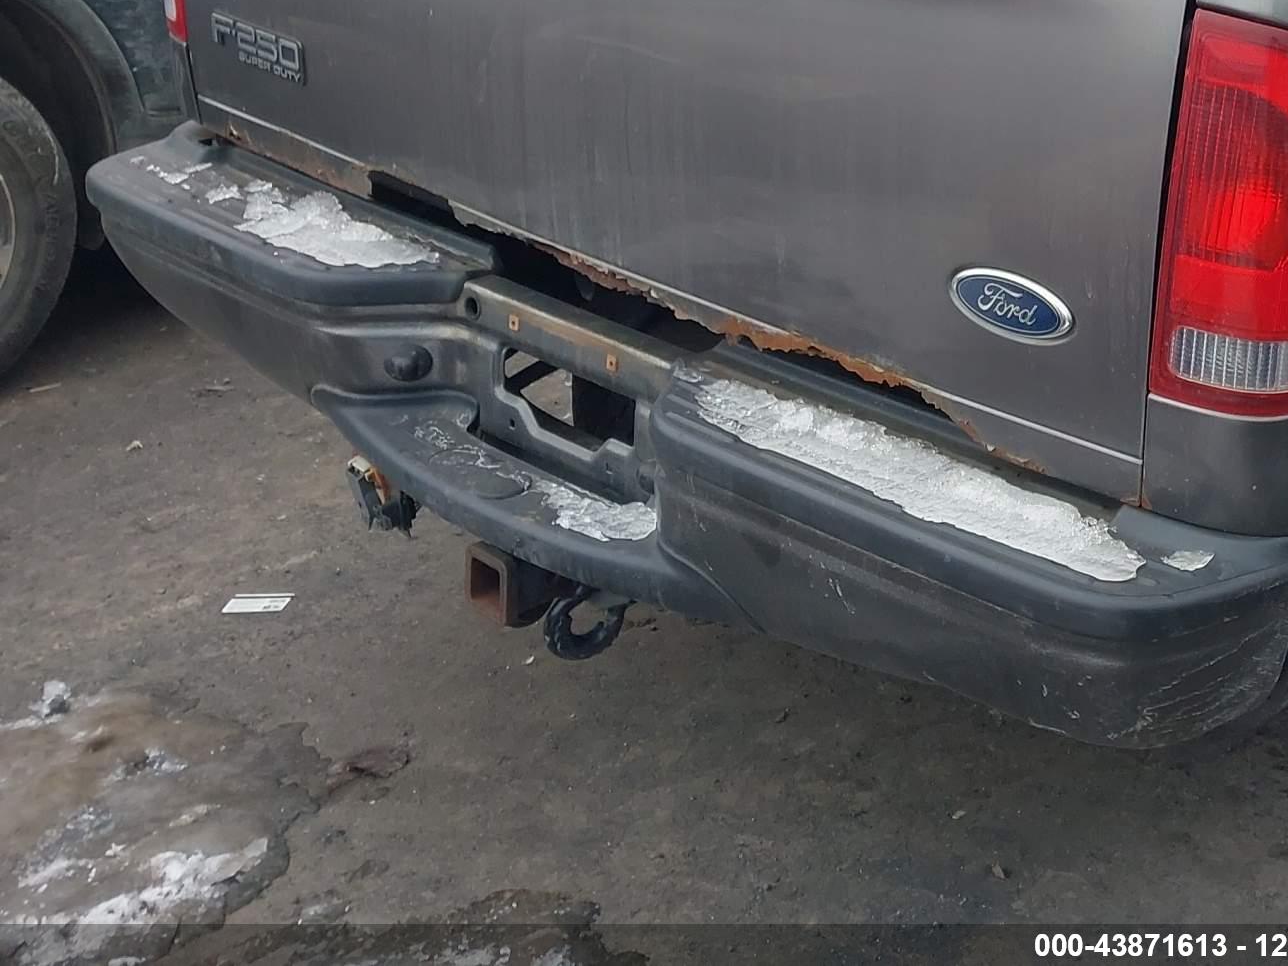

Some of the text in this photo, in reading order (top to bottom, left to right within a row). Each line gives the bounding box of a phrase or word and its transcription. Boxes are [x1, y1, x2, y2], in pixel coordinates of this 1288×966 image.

[238, 50, 302, 83] SUPER DUTY
[977, 282, 1038, 326] Ford
